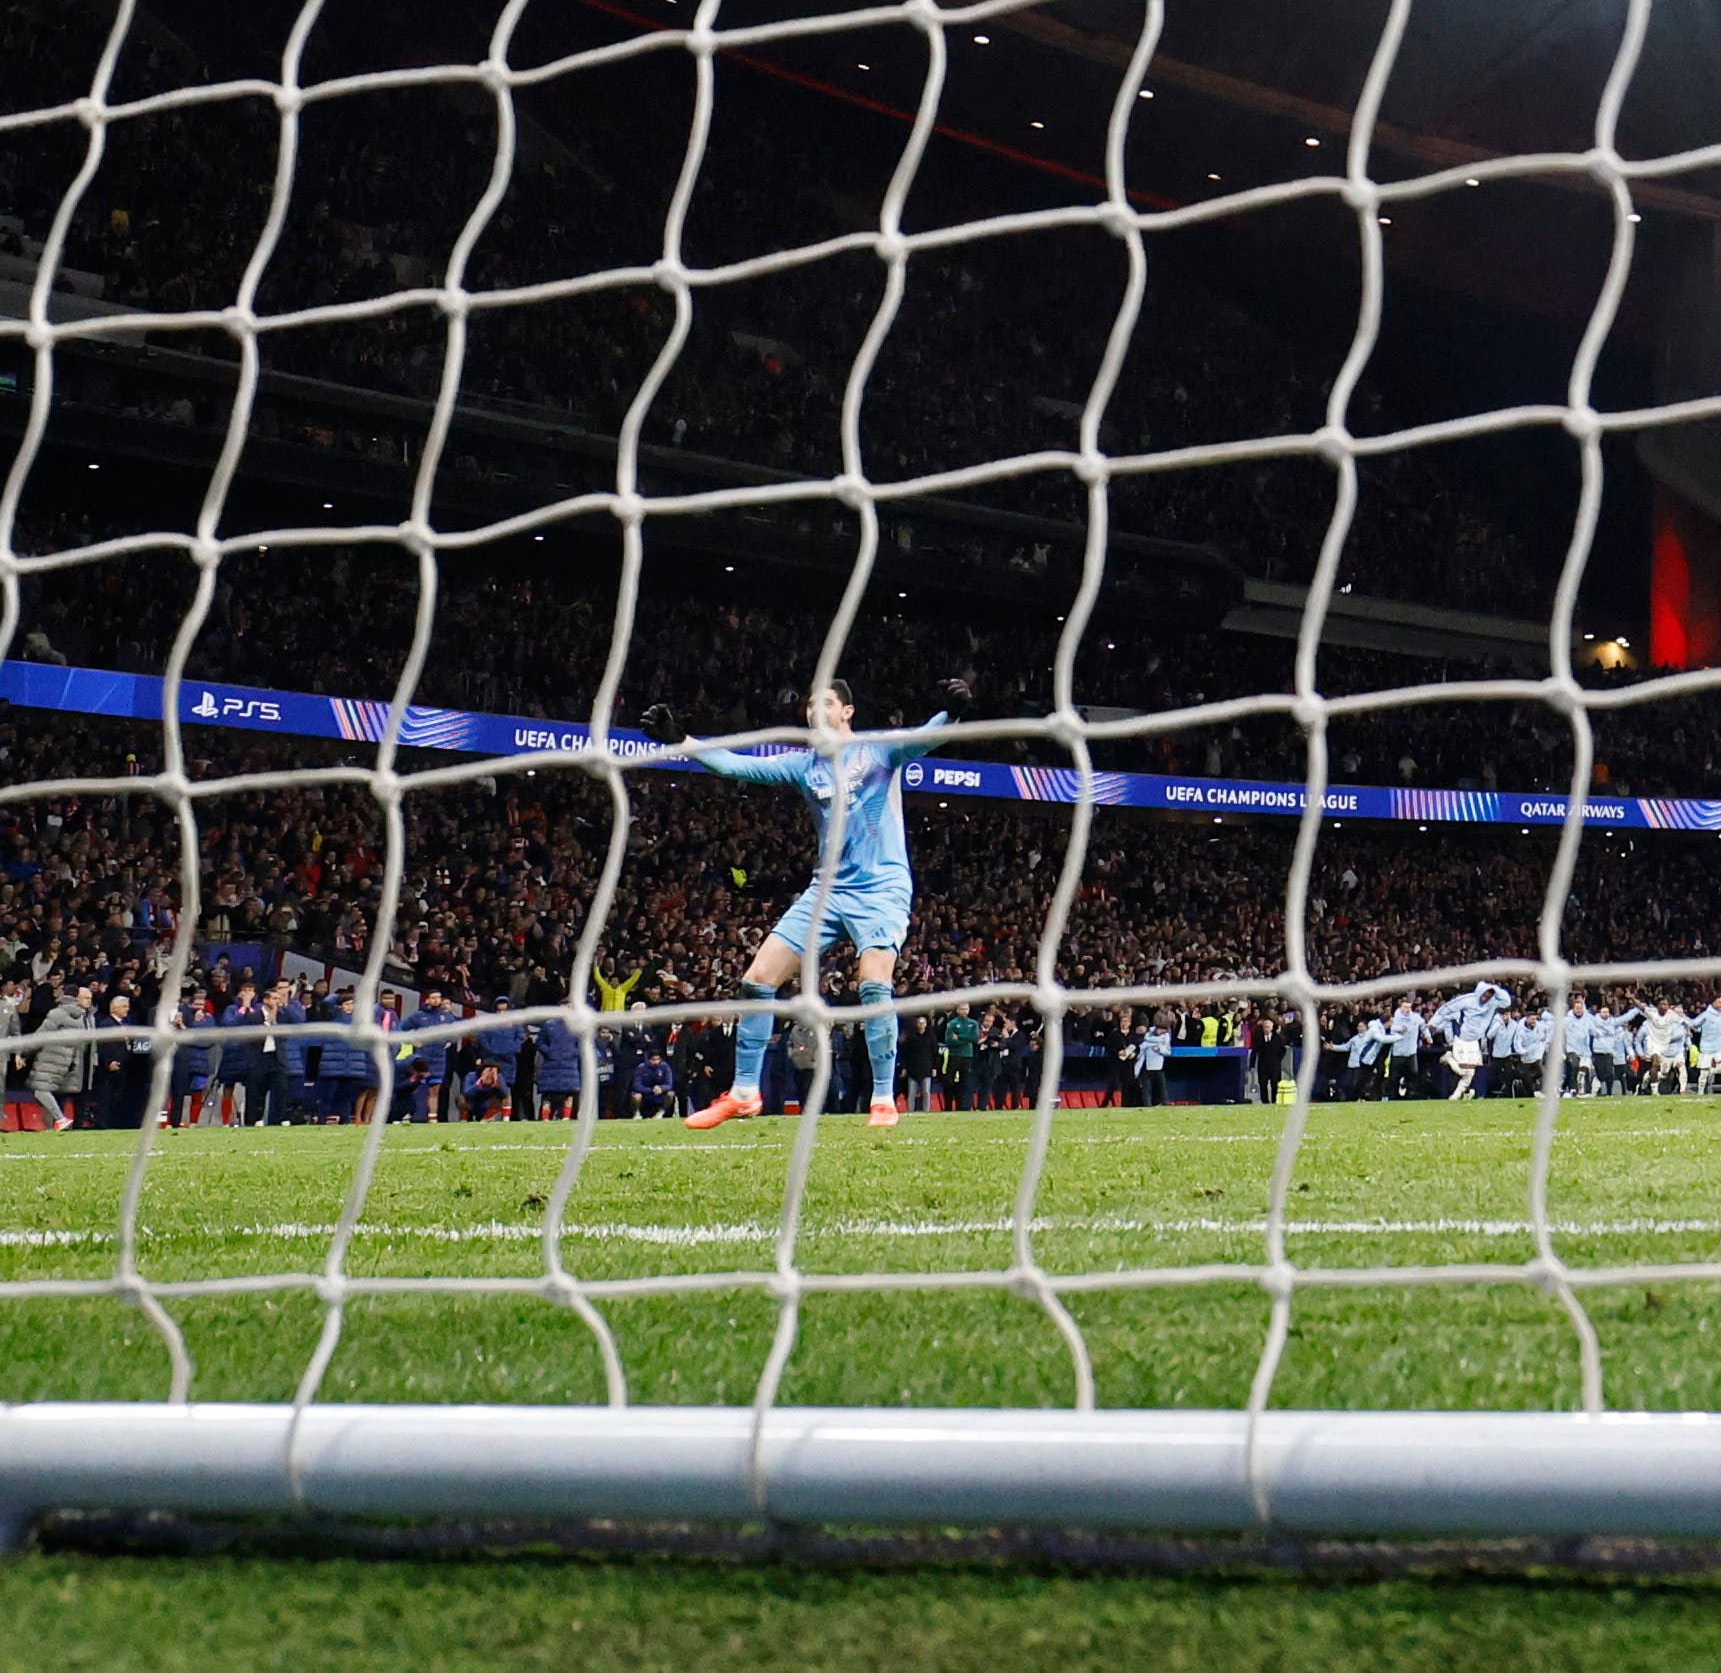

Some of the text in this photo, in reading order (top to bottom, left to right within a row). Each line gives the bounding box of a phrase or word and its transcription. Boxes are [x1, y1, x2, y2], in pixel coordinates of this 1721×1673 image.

[223, 698, 280, 720] PS5
[514, 729, 557, 750] UEFA
[560, 734, 658, 759] CHAPIONS
[934, 769, 981, 787] PEPSI
[1166, 786, 1358, 810] UEFA CHAMPIONS LAGUE
[1520, 802, 1625, 819] QATAR RWAYS
